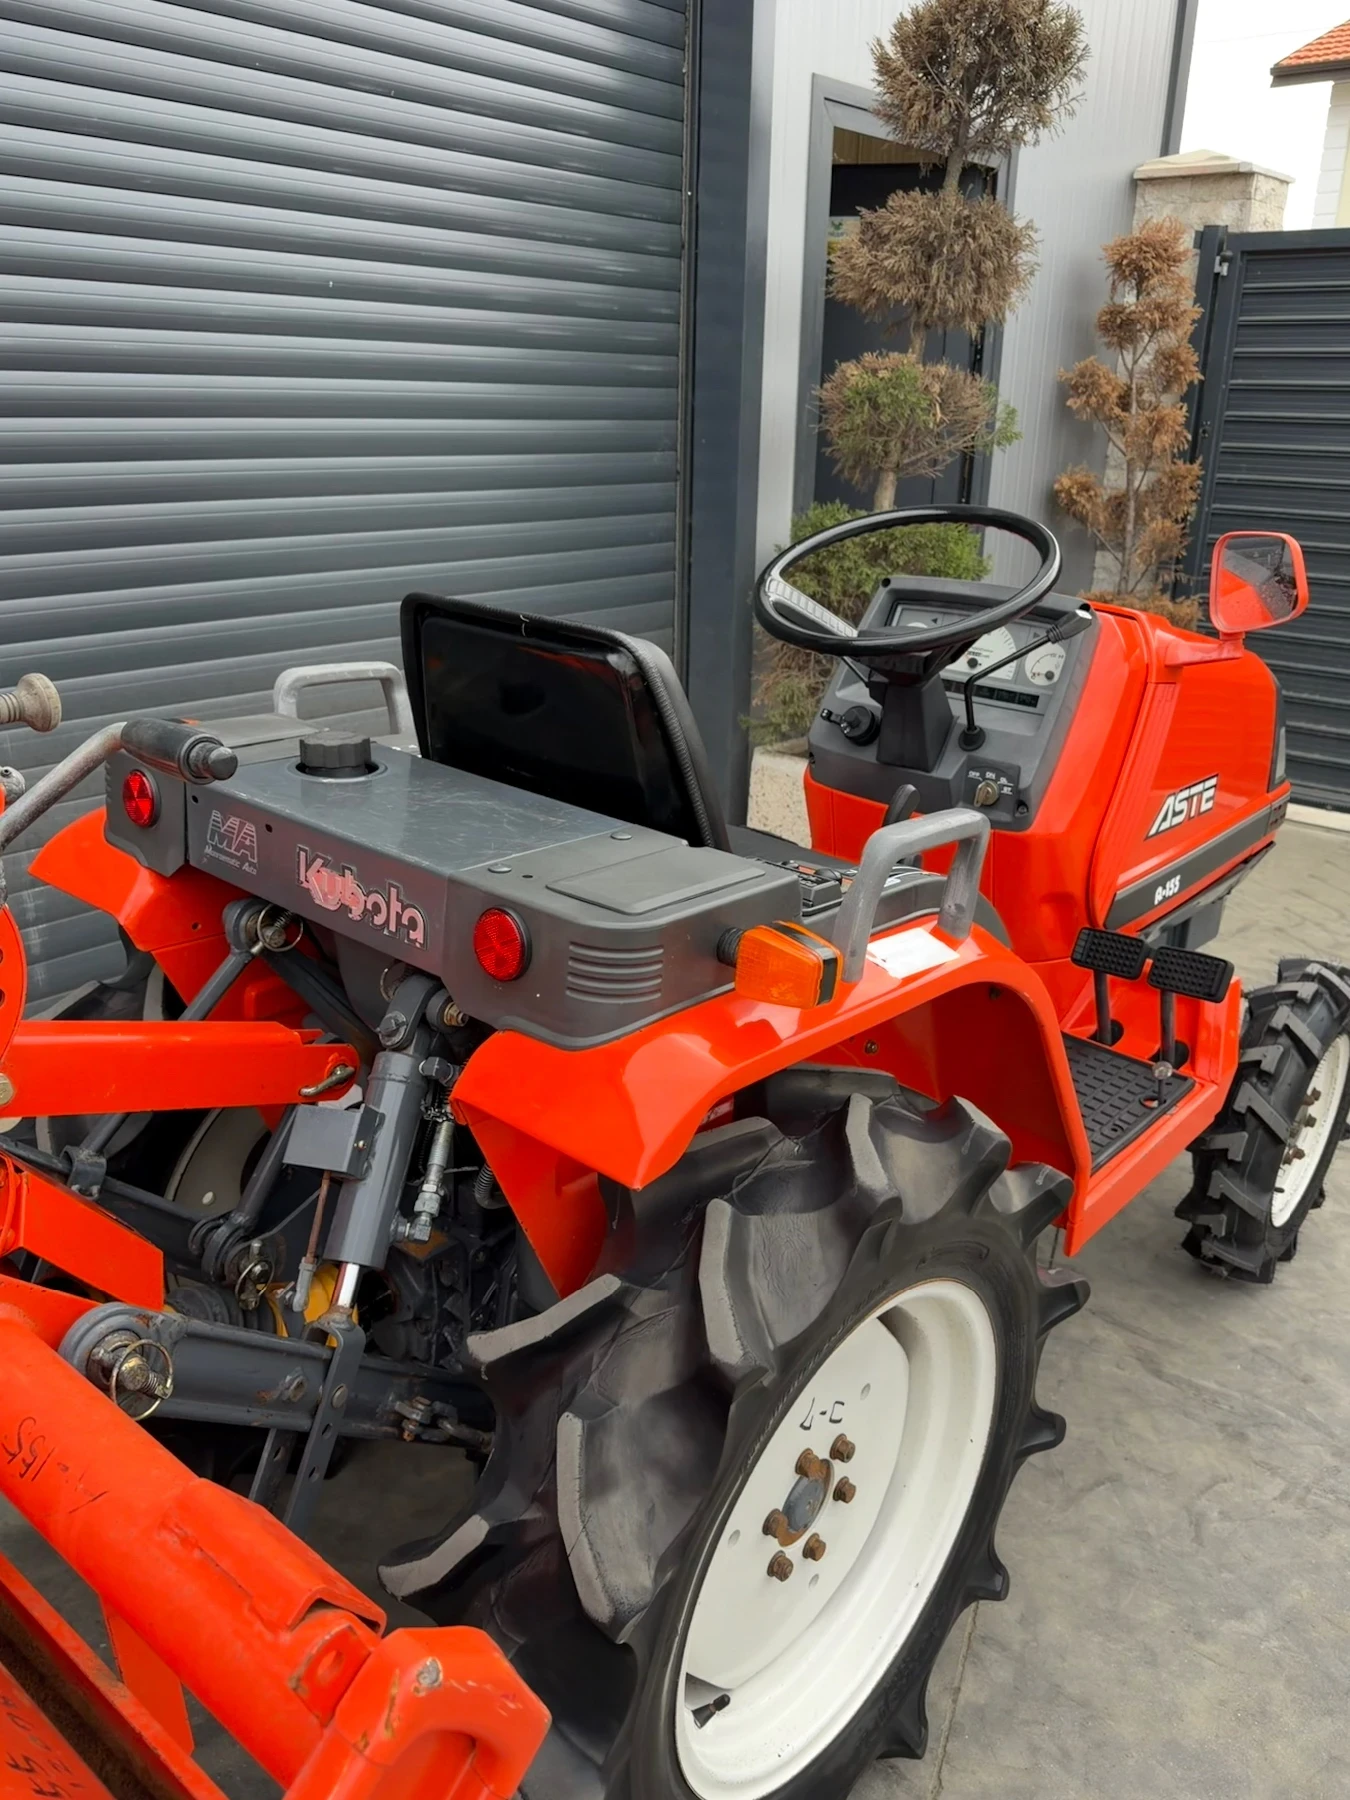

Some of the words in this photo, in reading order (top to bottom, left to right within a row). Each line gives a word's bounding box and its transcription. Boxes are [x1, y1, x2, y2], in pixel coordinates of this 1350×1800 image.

[207, 809, 257, 863] MA
[1144, 773, 1218, 840] ASTE
[296, 844, 427, 949] Kubota
